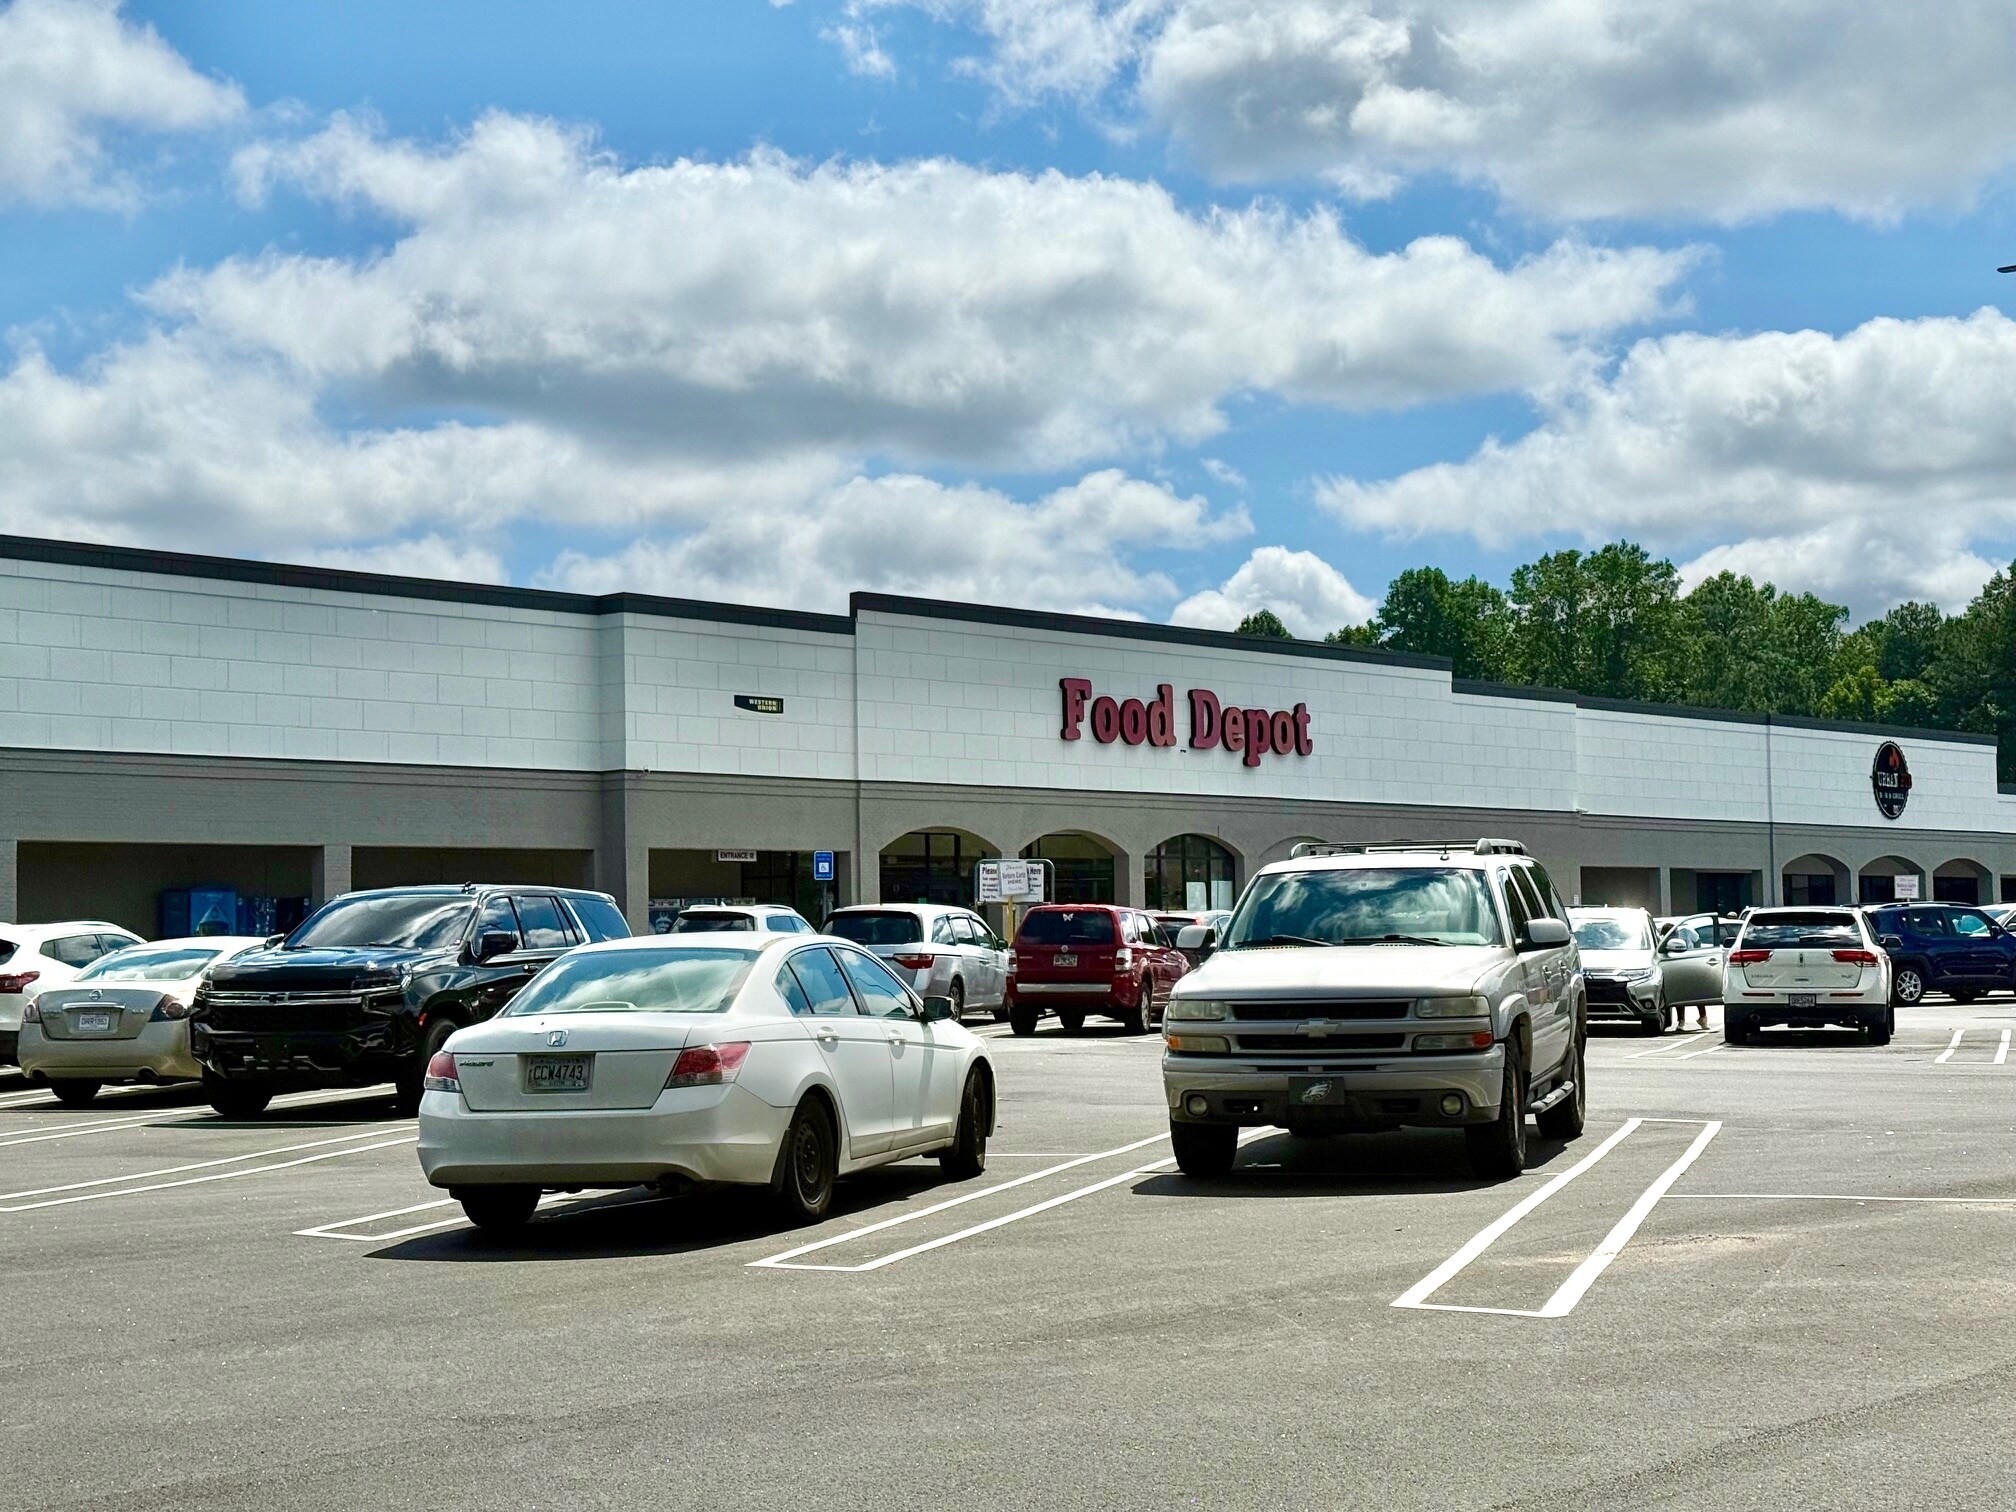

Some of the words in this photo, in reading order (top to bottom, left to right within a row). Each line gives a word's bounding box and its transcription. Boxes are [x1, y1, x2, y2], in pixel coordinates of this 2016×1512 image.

[1059, 677, 1177, 747] Food
[1187, 688, 1313, 767] Depot
[1877, 771, 1899, 788] URBAN
[720, 851, 748, 859] ENTRANCE
